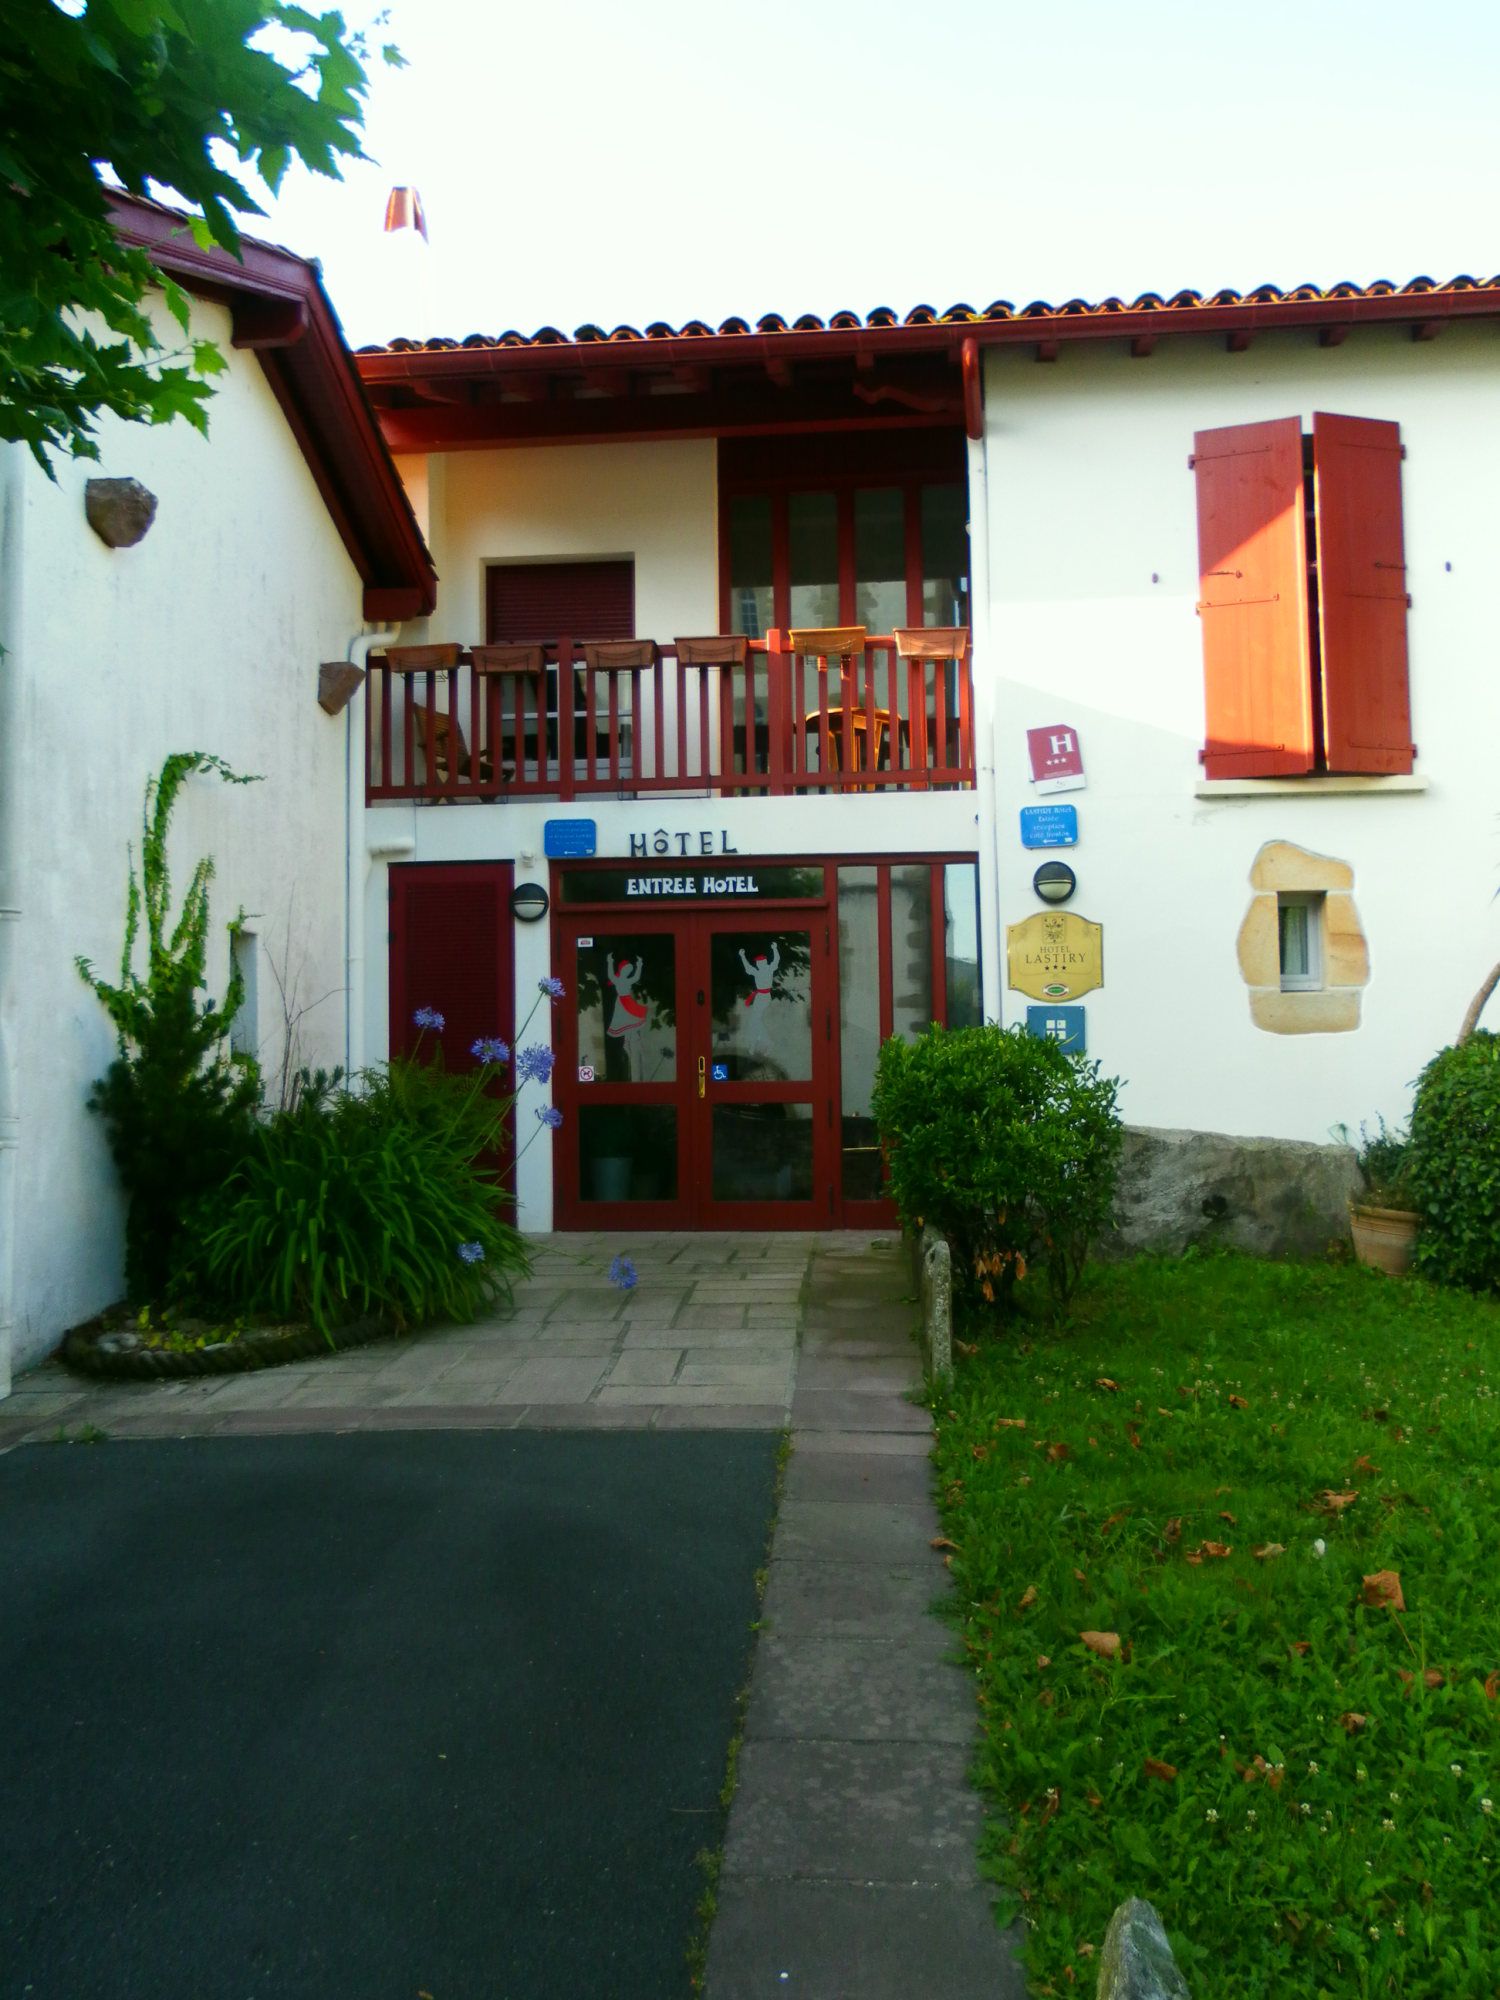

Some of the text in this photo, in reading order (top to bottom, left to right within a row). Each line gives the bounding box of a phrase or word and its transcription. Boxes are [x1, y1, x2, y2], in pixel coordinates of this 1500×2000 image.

[1050, 733, 1074, 754] H
[629, 828, 738, 857] HÔTEL
[627, 877, 696, 895] ENTREE
[1025, 952, 1086, 964] LASTIRY
[1040, 945, 1071, 953] HOTEL
